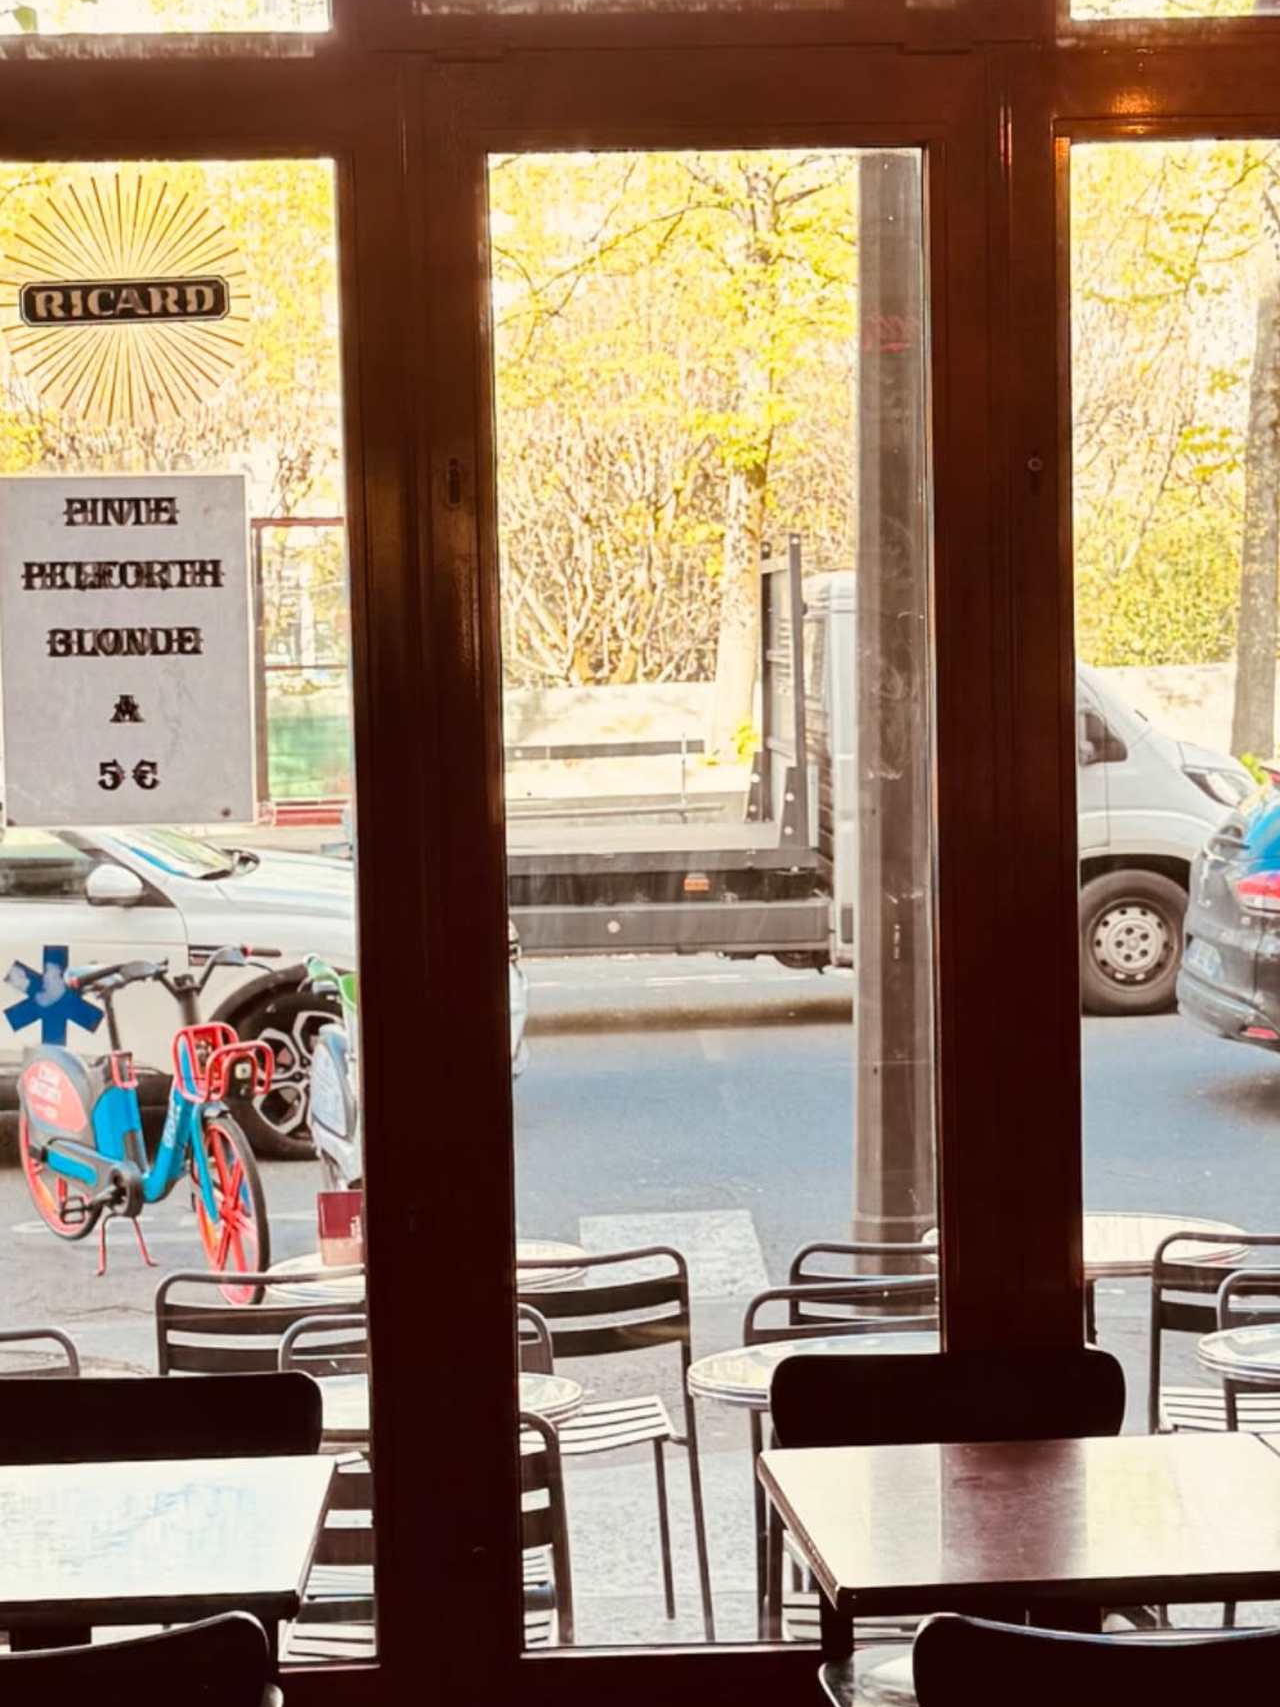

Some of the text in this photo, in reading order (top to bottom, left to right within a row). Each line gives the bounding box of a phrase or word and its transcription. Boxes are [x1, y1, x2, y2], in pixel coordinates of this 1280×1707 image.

[34, 283, 217, 320] RICARD
[64, 496, 178, 527] PINTE
[22, 559, 225, 592] PELFORTH
[46, 626, 204, 658] BLONDE
